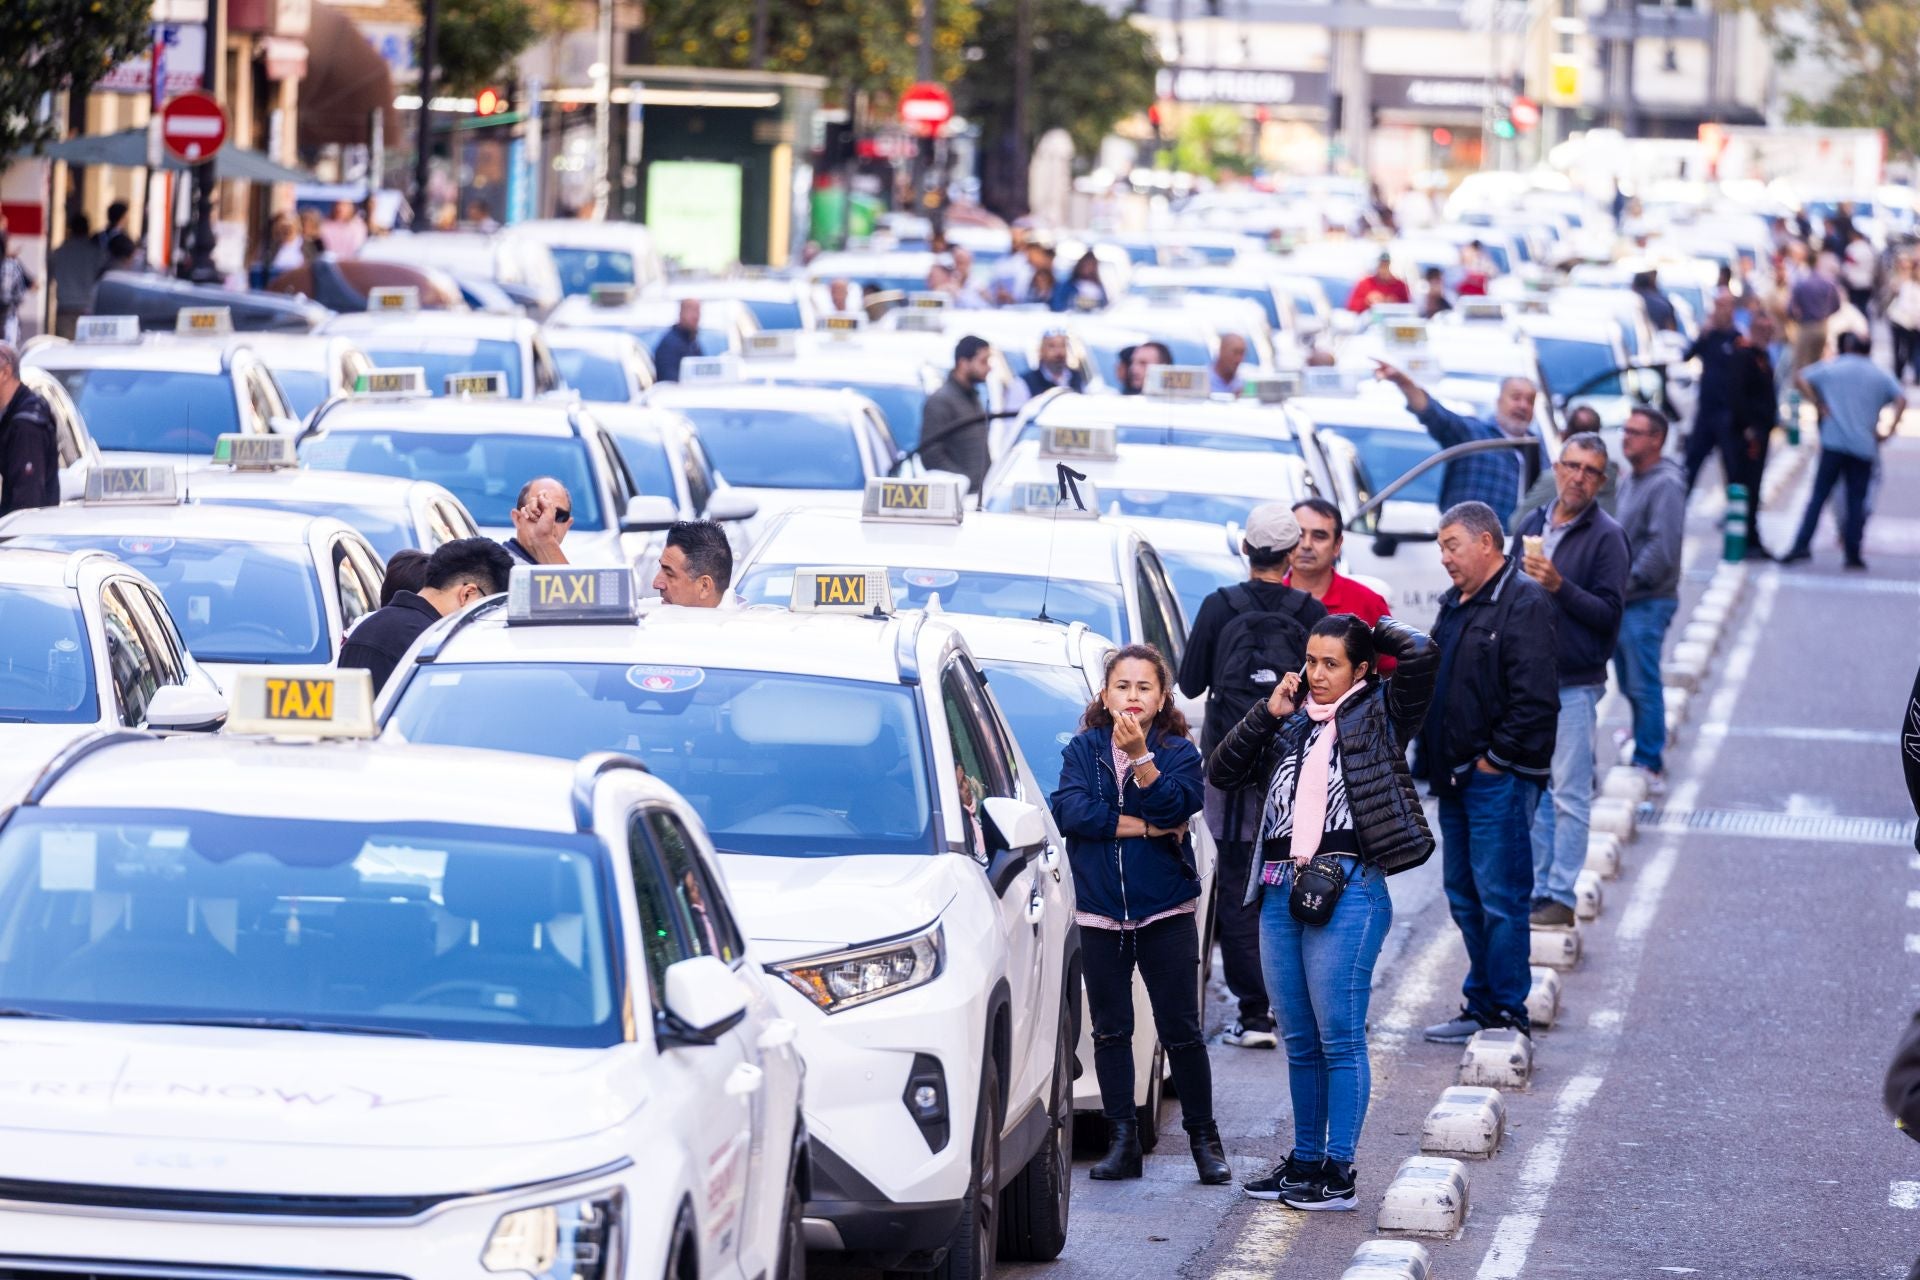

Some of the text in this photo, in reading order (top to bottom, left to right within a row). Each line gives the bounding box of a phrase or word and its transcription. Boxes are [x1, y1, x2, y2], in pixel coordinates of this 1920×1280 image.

[235, 440, 269, 459] TAXI
[105, 468, 147, 491] TAXI
[882, 485, 928, 507] TAXI
[1029, 485, 1060, 504] TAX
[533, 574, 594, 604] TAXI
[817, 576, 864, 602] TAXI
[266, 681, 333, 717] TAXI
